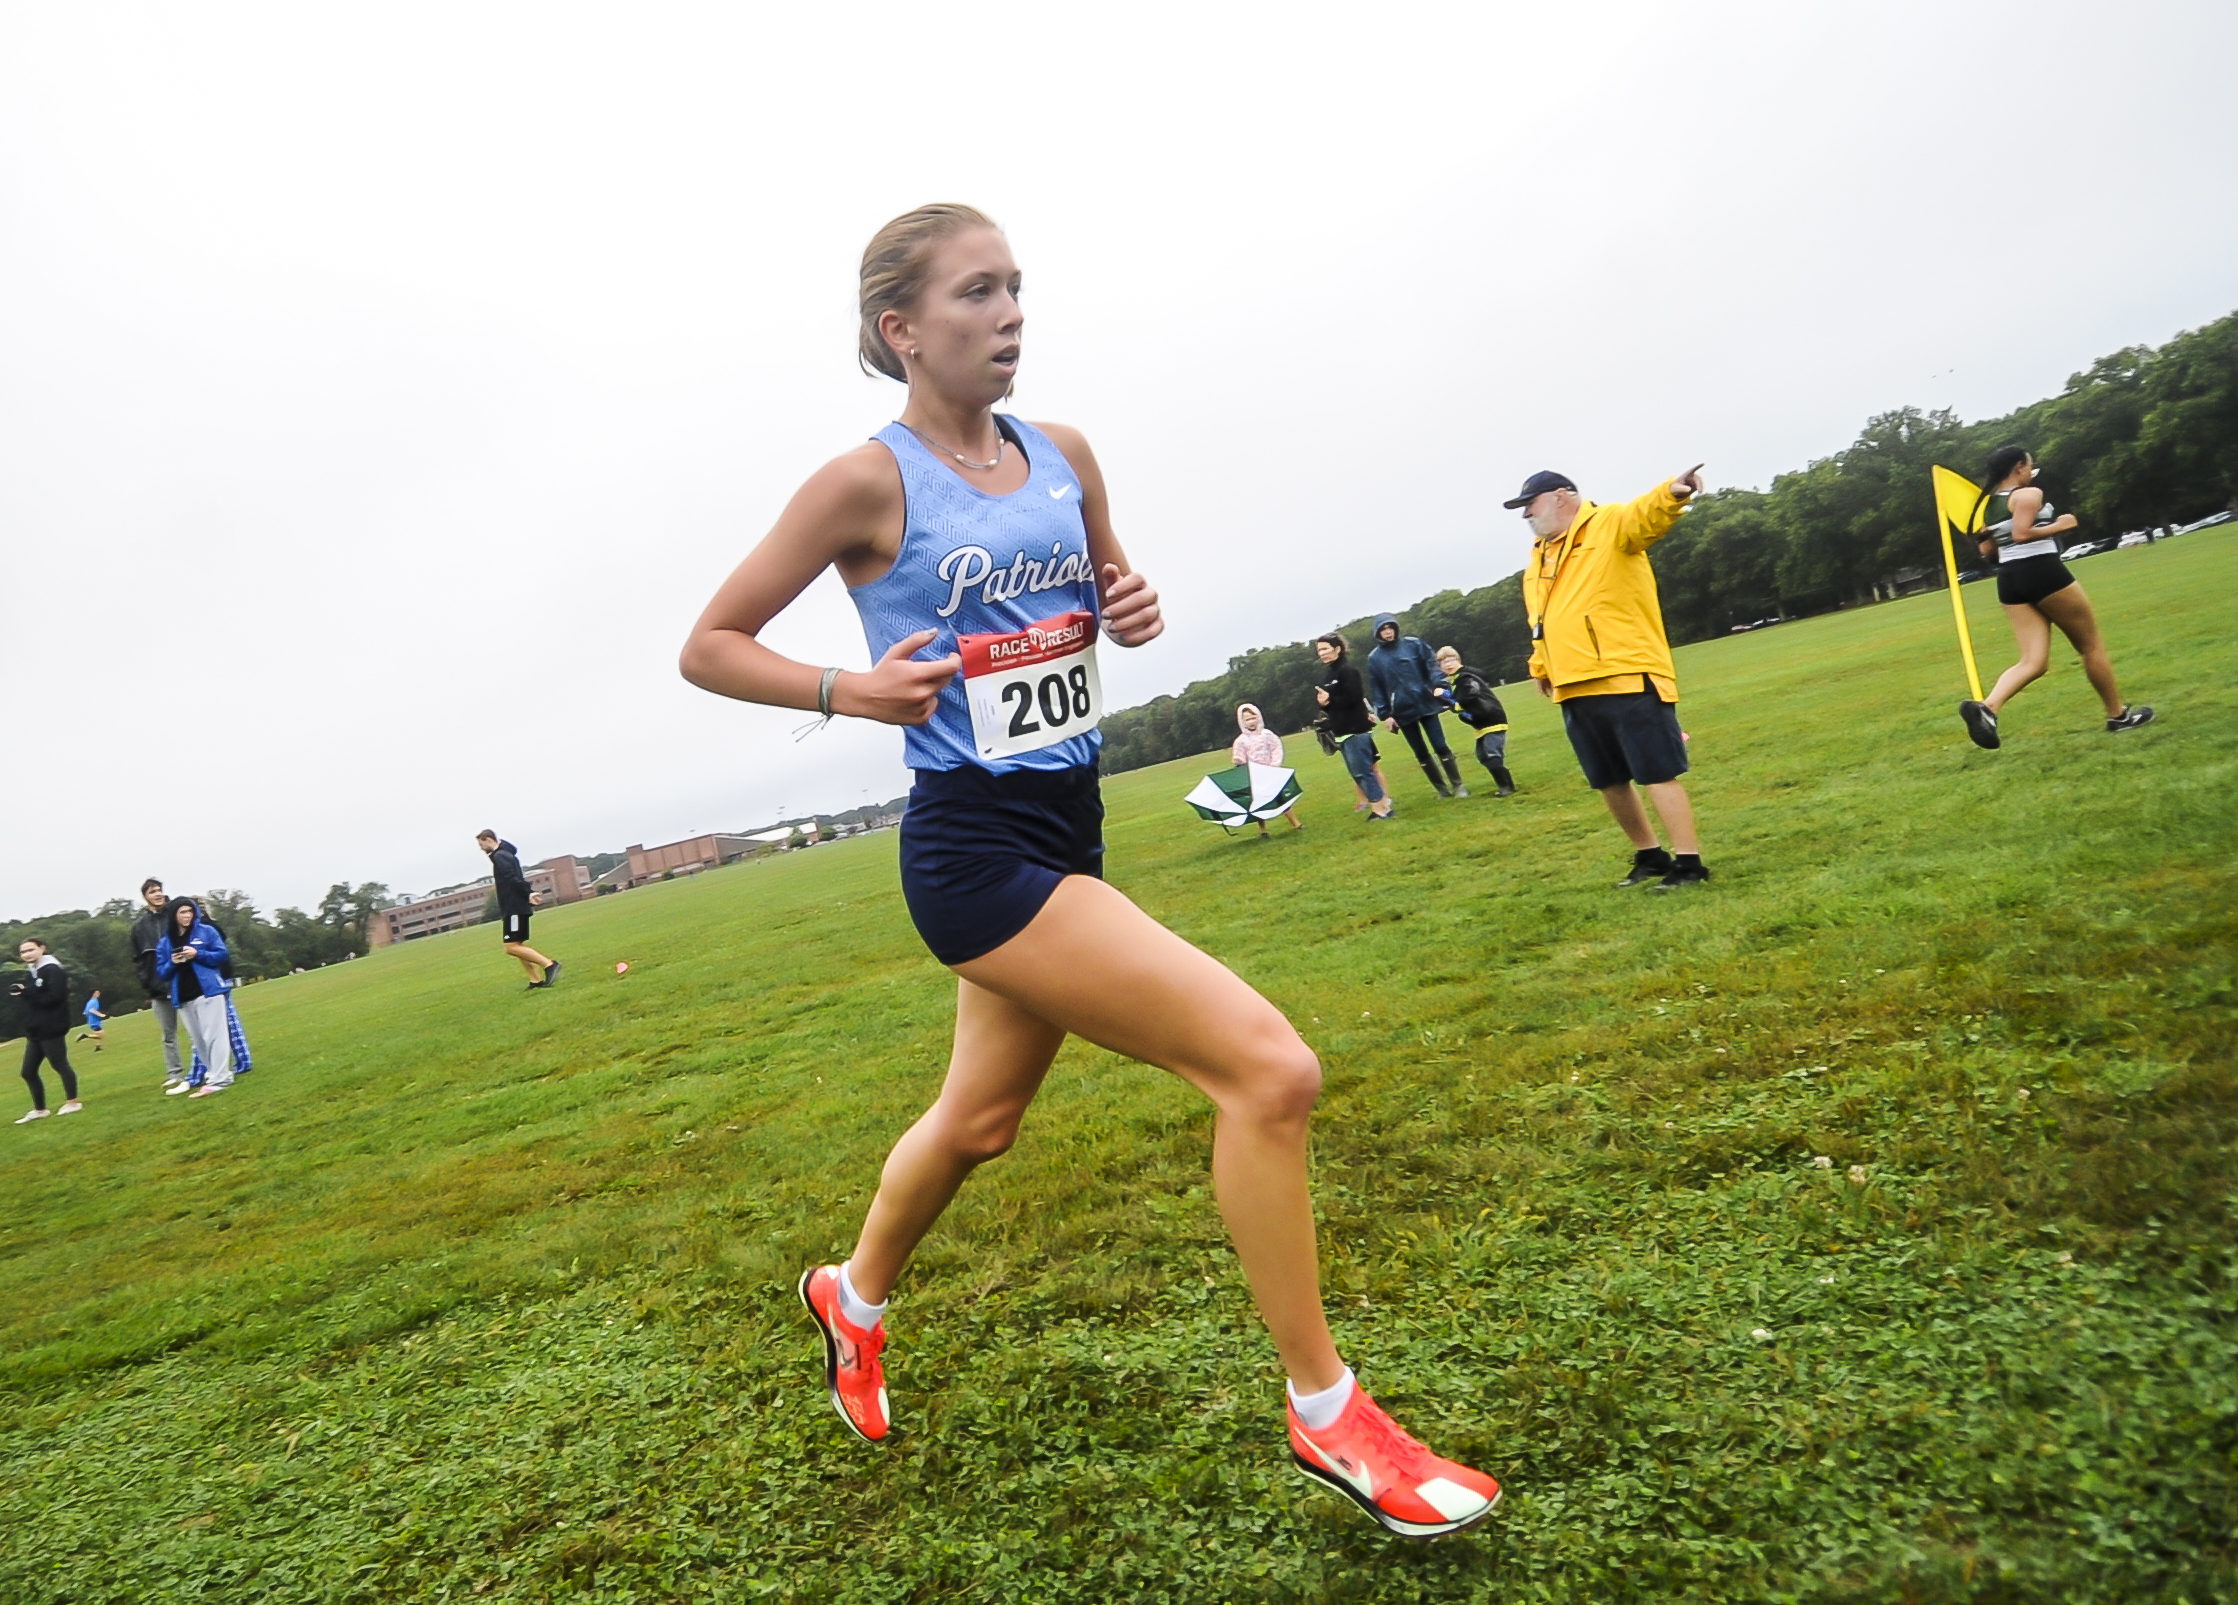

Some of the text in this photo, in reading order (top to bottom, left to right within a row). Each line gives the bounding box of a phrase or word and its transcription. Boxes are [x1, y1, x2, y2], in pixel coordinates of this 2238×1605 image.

[990, 637, 1031, 659] RACE
[1046, 621, 1084, 647] RESULT
[1002, 664, 1090, 738] 208
